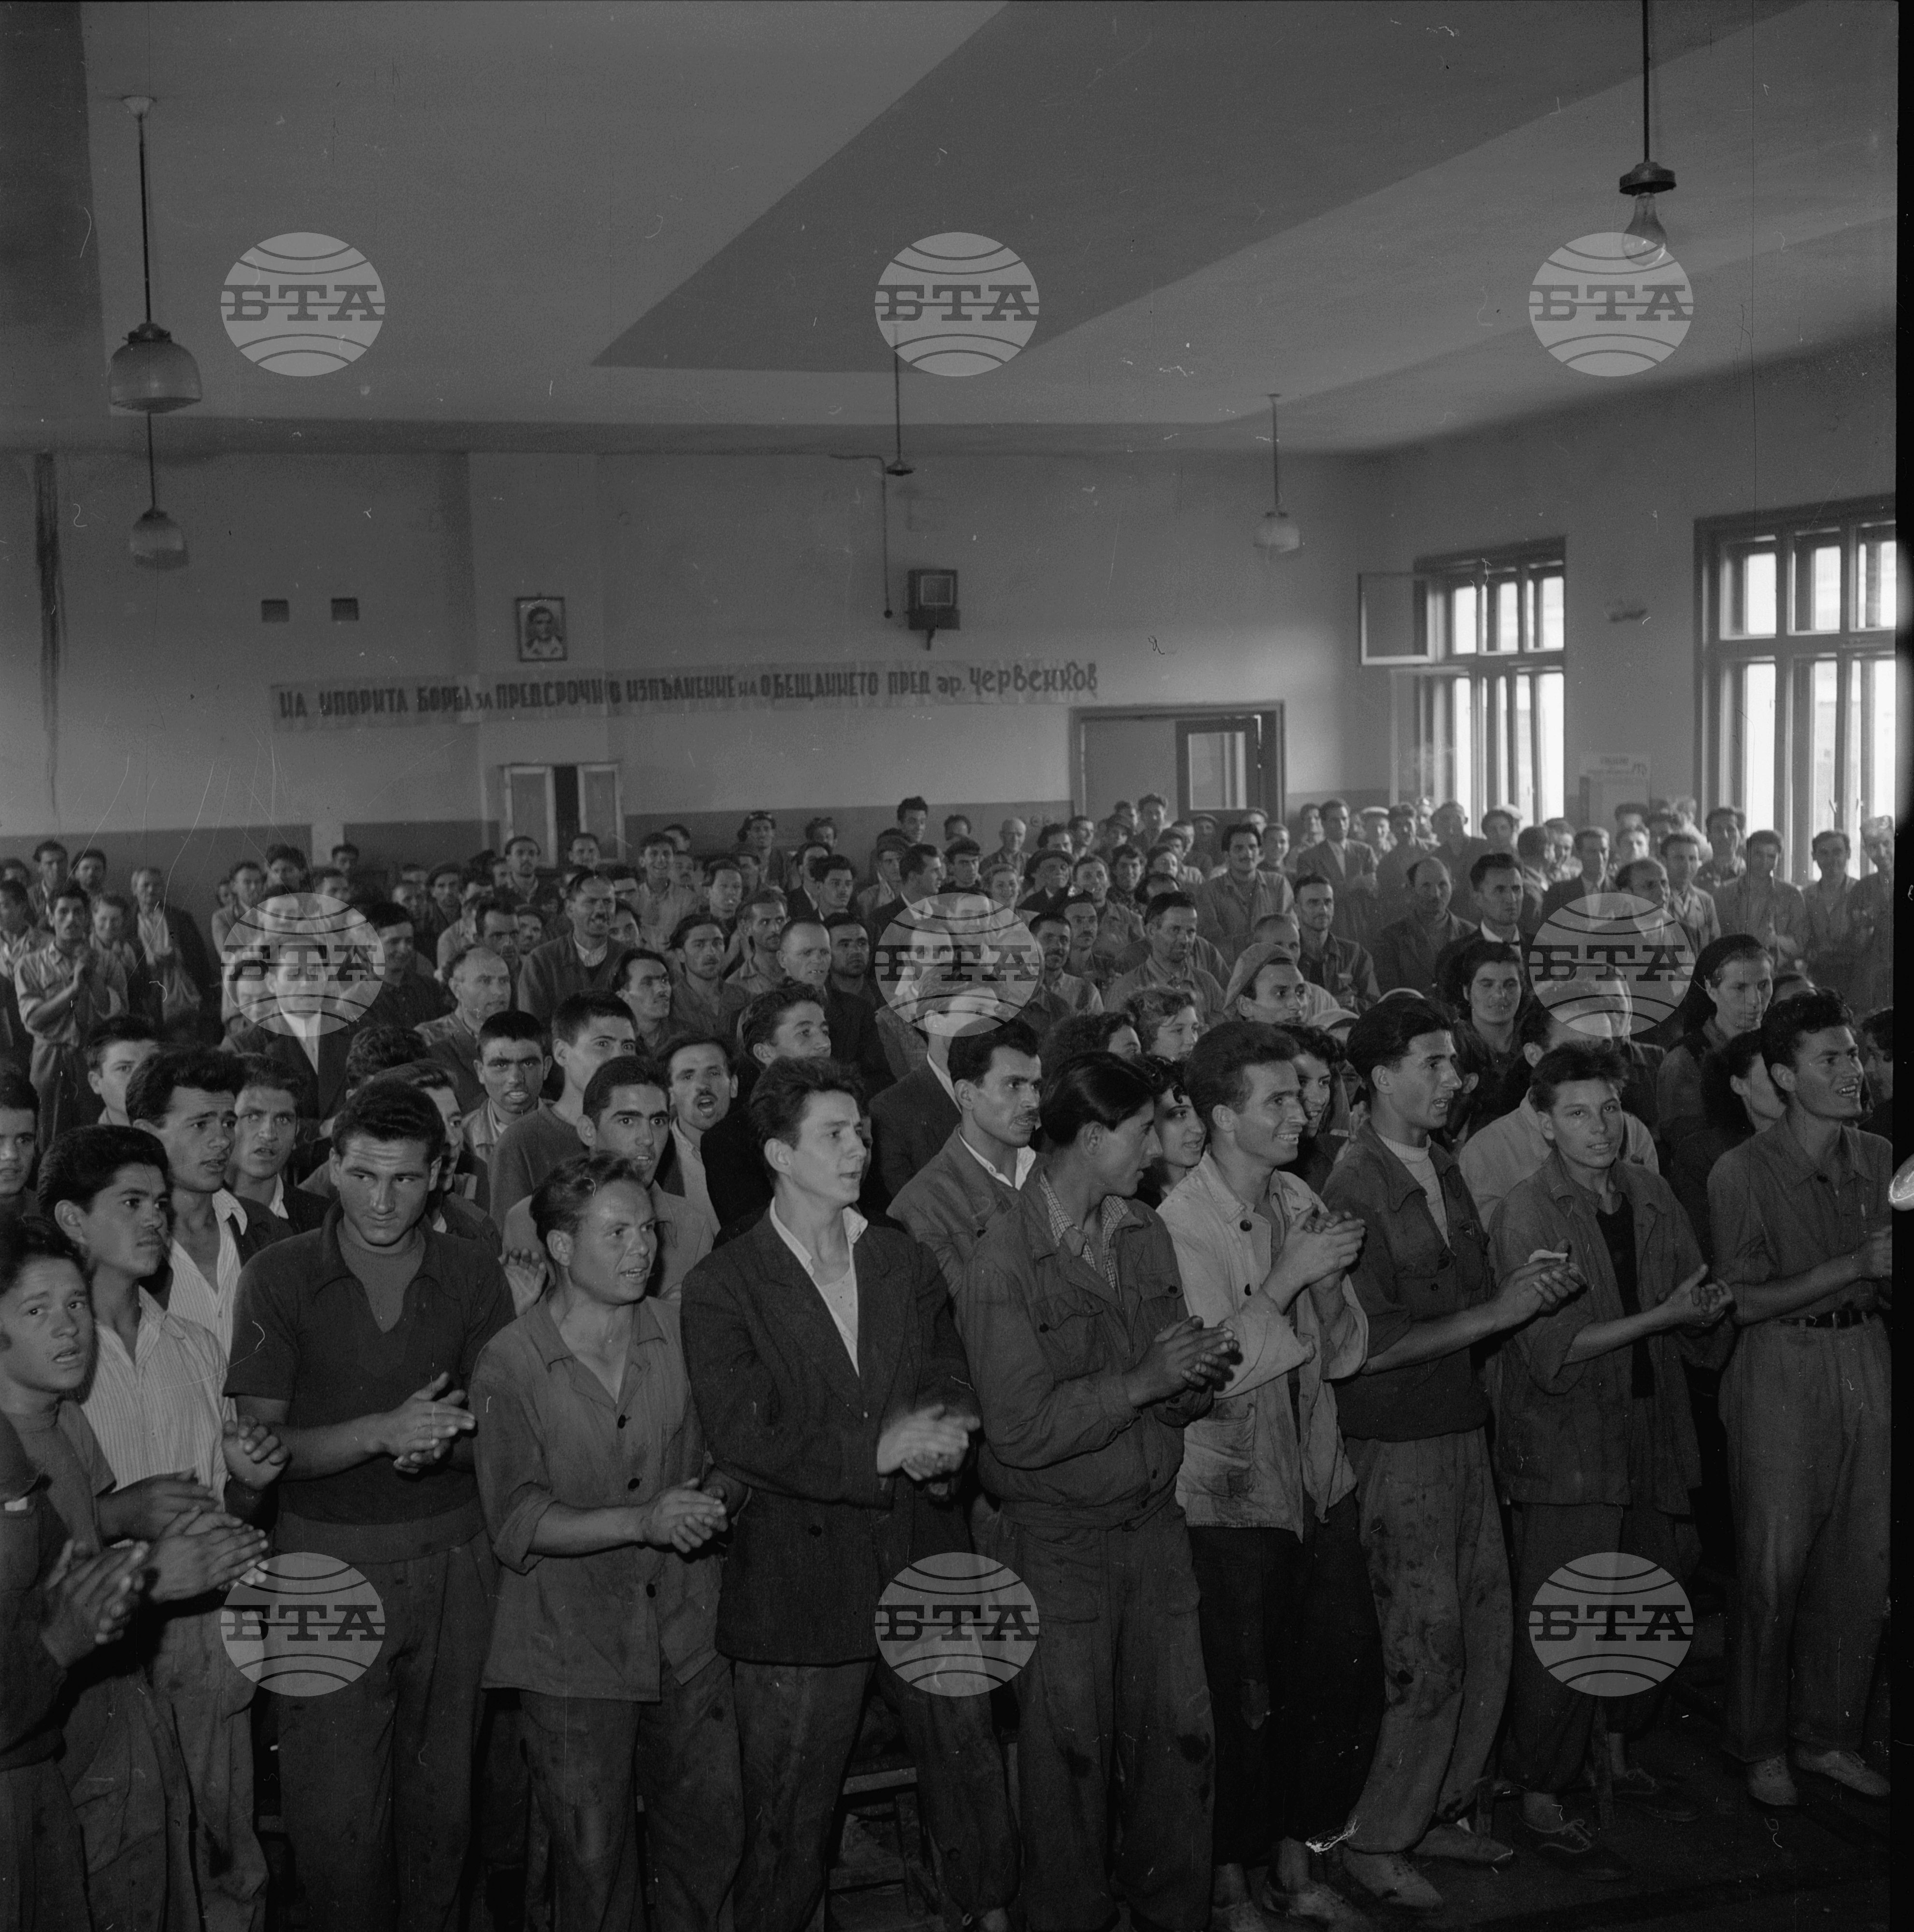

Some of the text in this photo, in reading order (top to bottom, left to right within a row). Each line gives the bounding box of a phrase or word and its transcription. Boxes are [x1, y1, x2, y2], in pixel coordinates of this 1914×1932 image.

[319, 687, 409, 717] УПОРИТА
[417, 685, 473, 712] БОРБА
[496, 678, 621, 709] ПРЕДСРОЧНО
[627, 675, 735, 702] ИЗПЪЛНЕНИЕ
[760, 671, 879, 701] ОБЕЩАНИЕТО
[887, 670, 931, 695] ПРЕД
